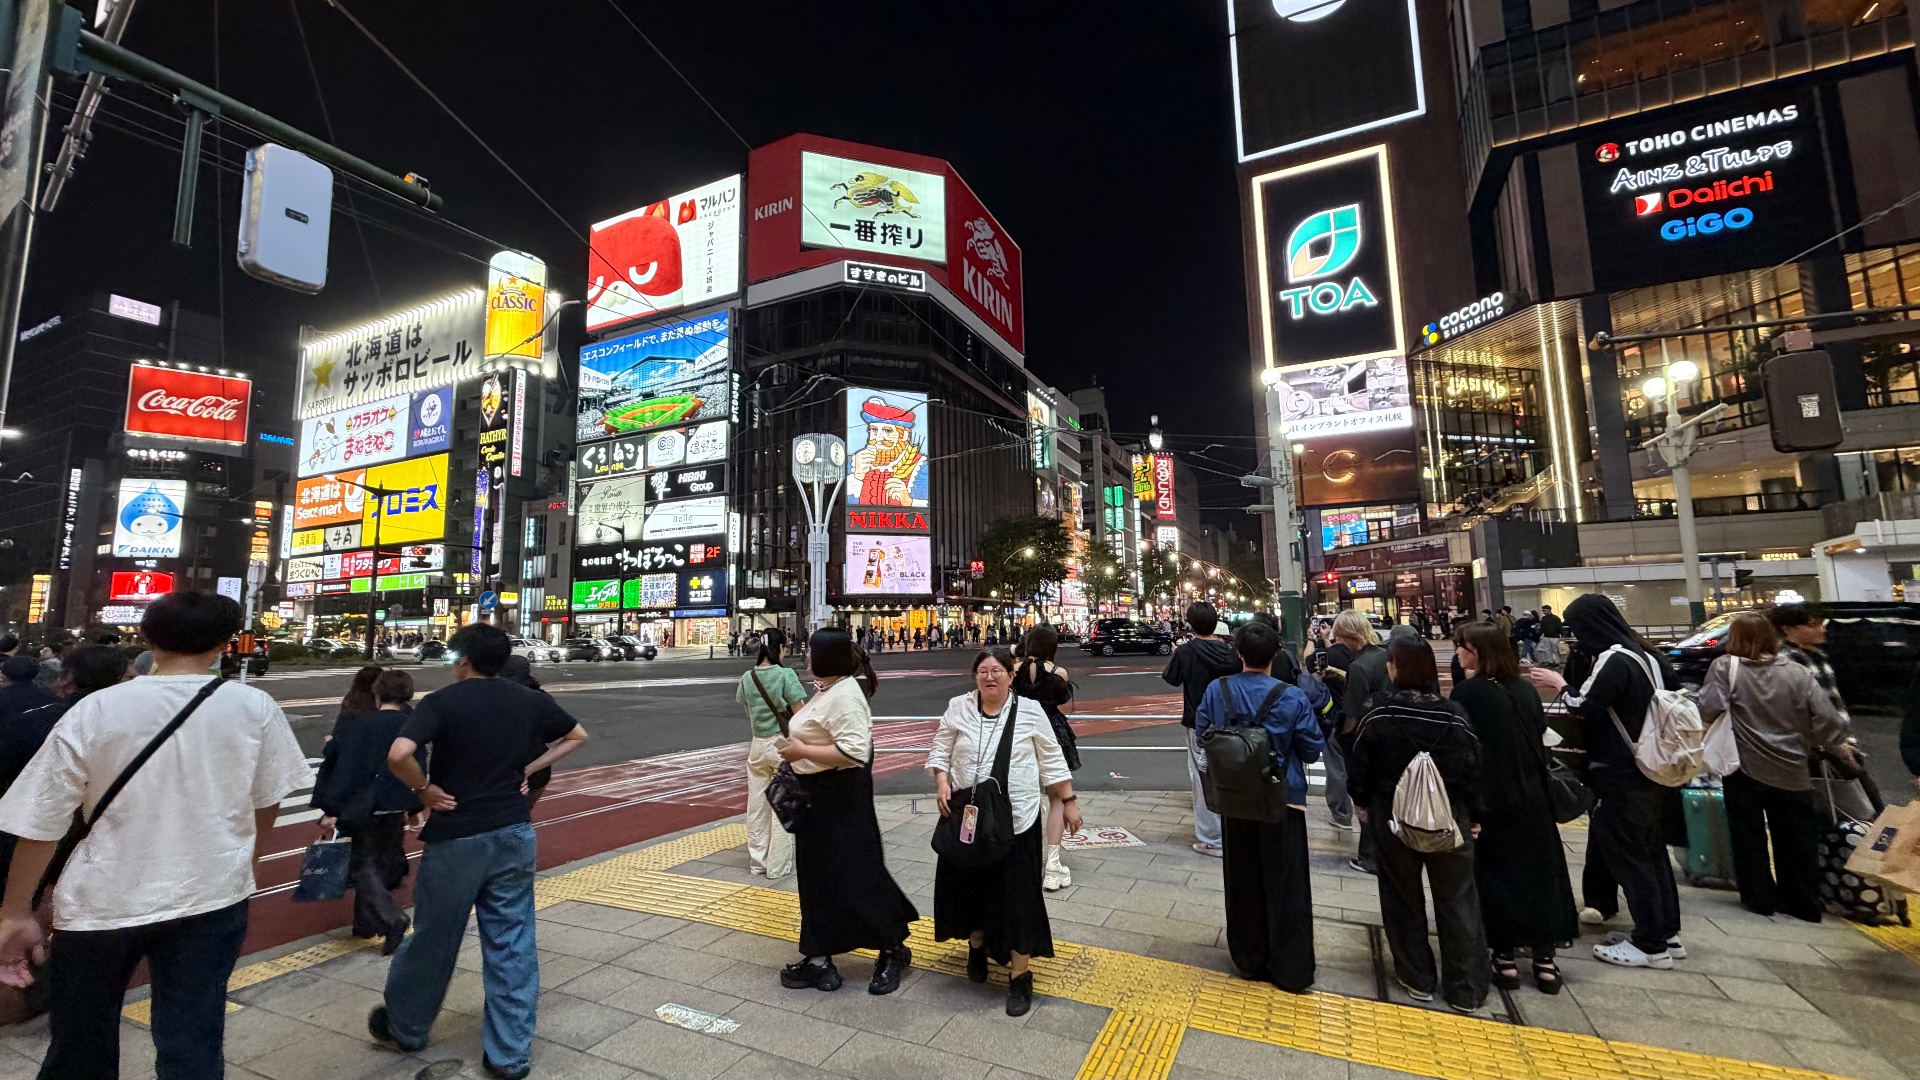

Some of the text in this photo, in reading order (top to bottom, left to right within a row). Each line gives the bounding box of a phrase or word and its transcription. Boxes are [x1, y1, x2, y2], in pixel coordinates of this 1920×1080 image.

[1625, 104, 1799, 156] TOHO CINEMAS
[699, 187, 737, 212] マルハン
[1668, 170, 1774, 209] Daiichi
[753, 196, 794, 221] KIRIN
[829, 218, 924, 250] 一番搾り
[1660, 206, 1754, 241] GiGO
[849, 266, 922, 288] すすきのビル
[491, 295, 537, 311] CLASSIC
[961, 256, 1014, 333] KIRIN
[1279, 276, 1379, 321] TOA
[344, 321, 423, 368] 北海道は
[343, 339, 473, 397] サッポロビール
[137, 388, 244, 421] Coca-Cola
[307, 395, 335, 411] SAPPORO
[351, 406, 390, 429] カラオケ
[343, 429, 396, 462] まねきねこ
[582, 441, 636, 470] くろねこ
[677, 469, 708, 484] HIBIKI
[689, 481, 715, 493] Group
[300, 481, 341, 505] 北海道は
[371, 484, 438, 519] プロミス
[581, 486, 590, 496] 9F
[849, 511, 929, 530] NIKKA
[332, 526, 353, 547] 牛角
[129, 545, 175, 555] DAIKIN
[705, 545, 721, 558] 2F
[585, 581, 619, 602] エイブル
